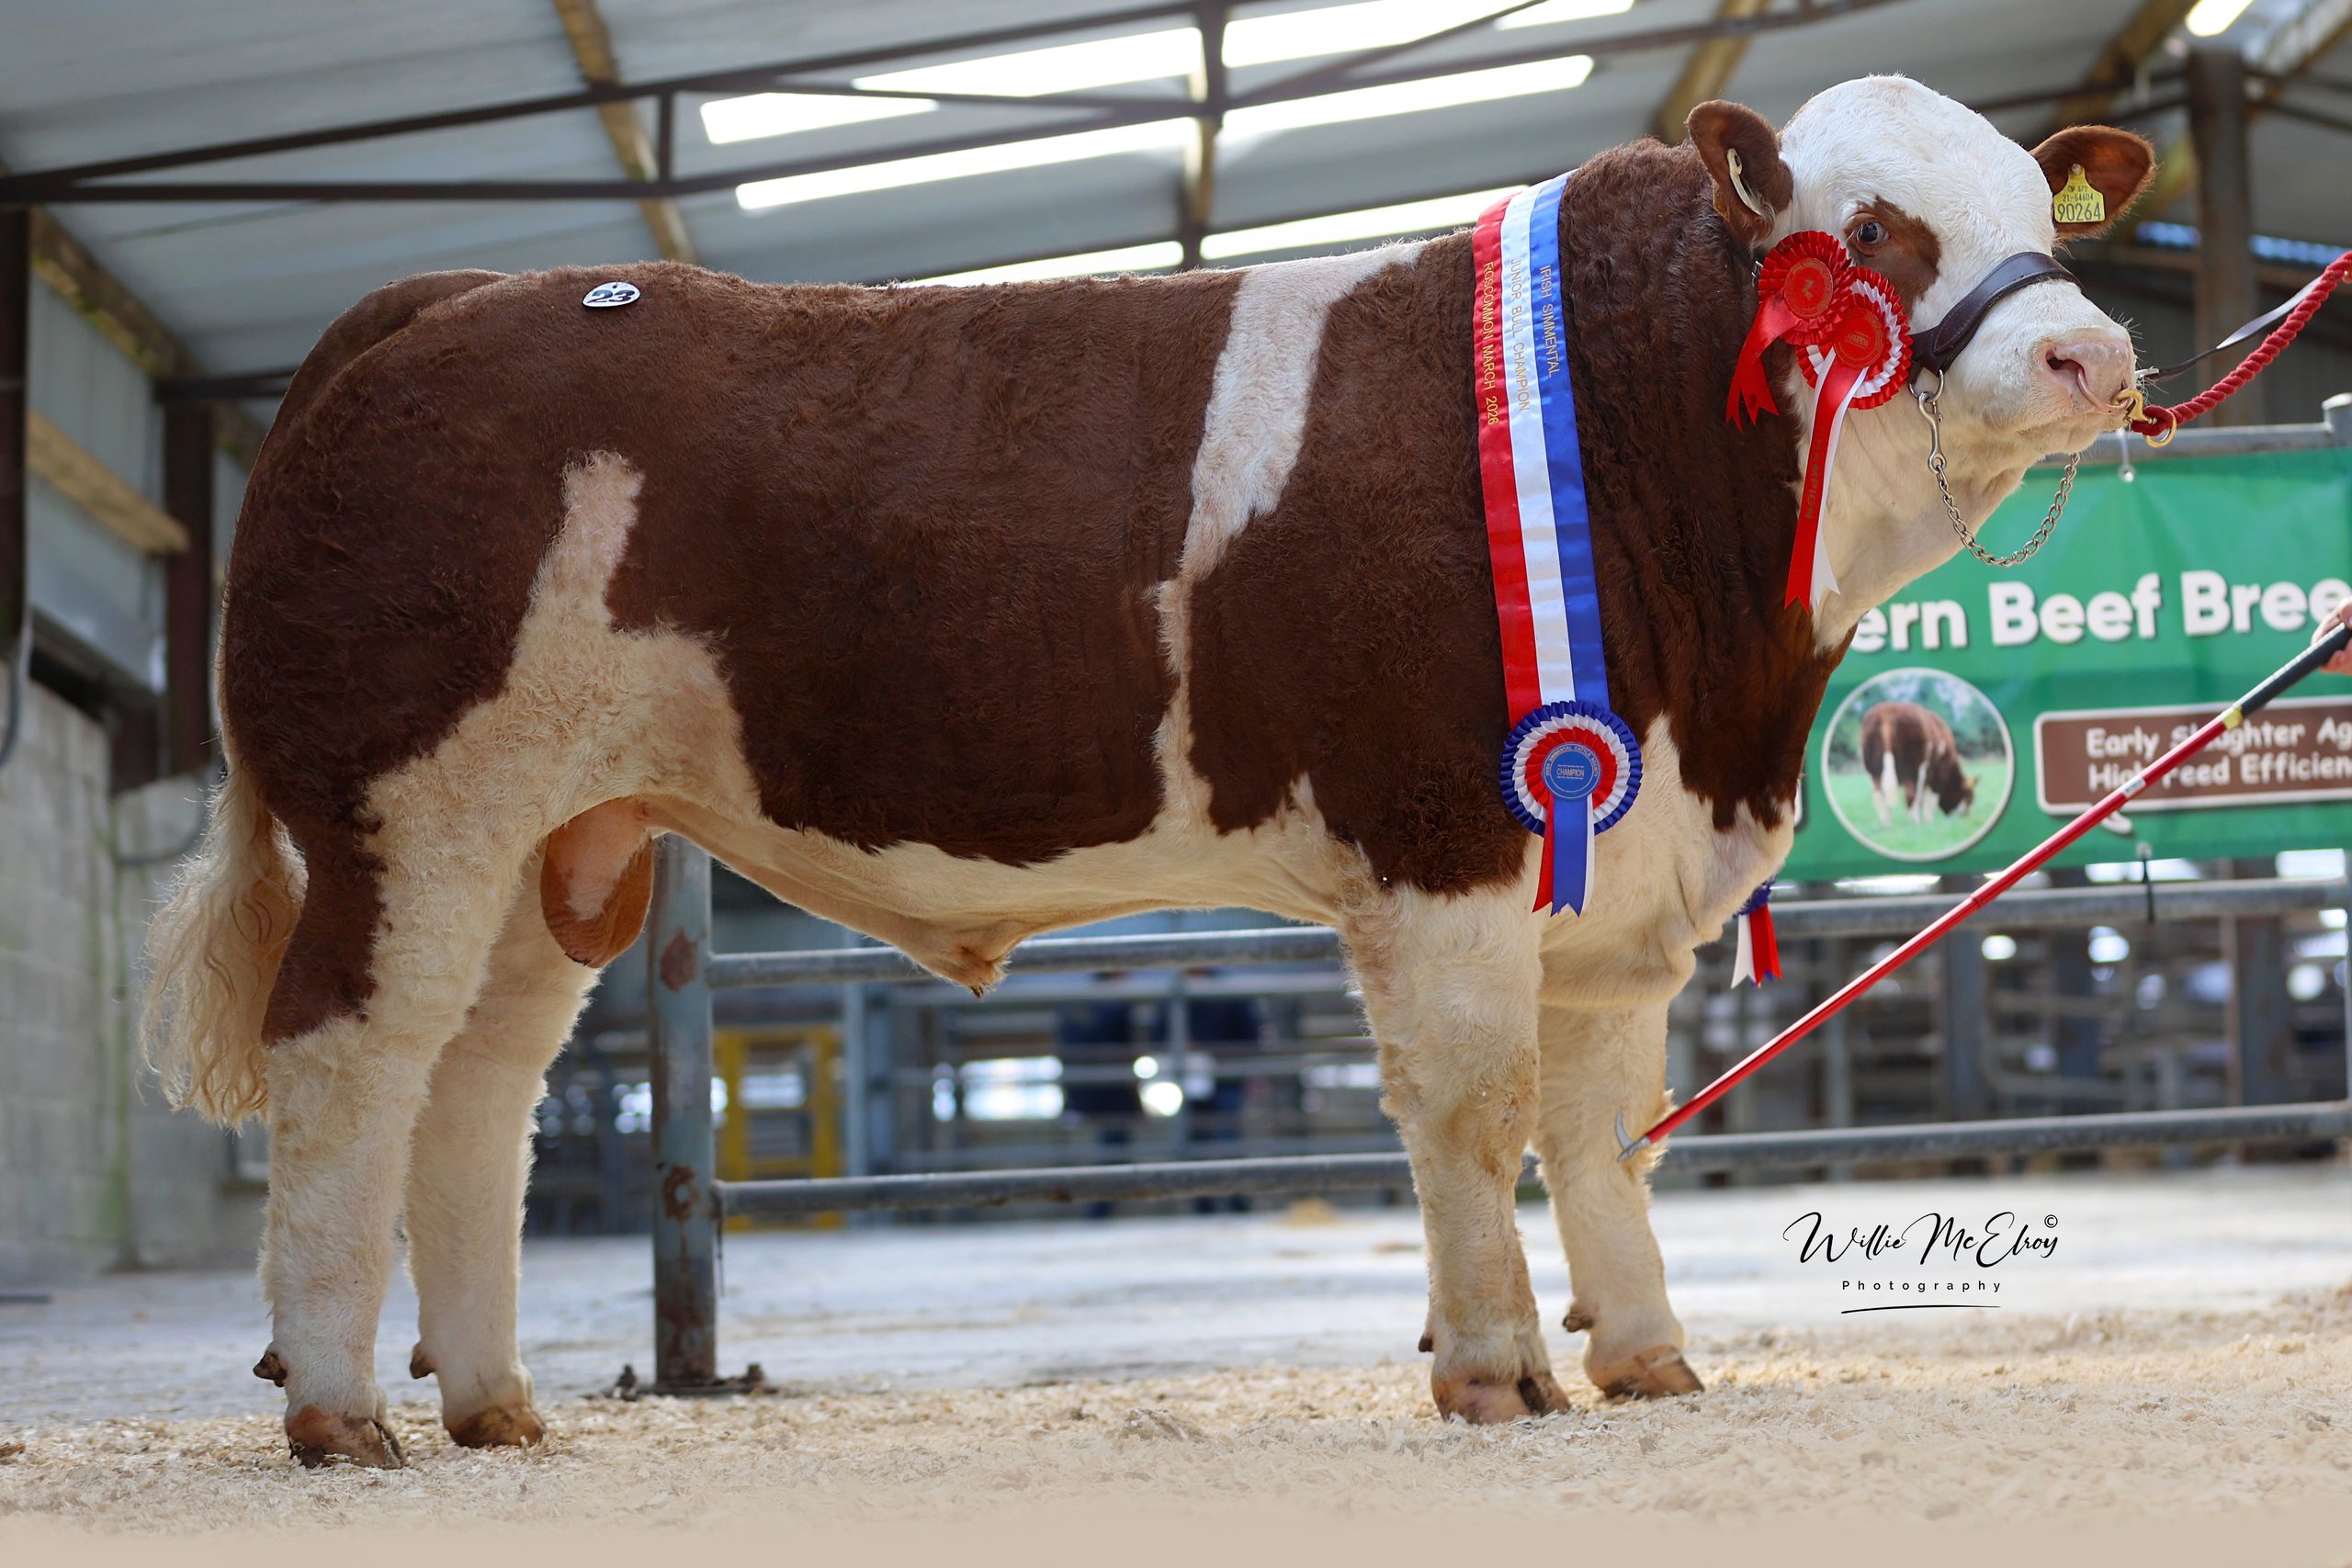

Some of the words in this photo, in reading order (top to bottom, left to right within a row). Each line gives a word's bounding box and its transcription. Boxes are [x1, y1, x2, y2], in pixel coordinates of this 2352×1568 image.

[2058, 203, 2101, 220] 90264
[587, 289, 635, 303] 23
[1510, 258, 1522, 302] JUNIOR
[1540, 265, 1552, 299] IRISH
[1481, 262, 1495, 339] ROSCOMMON
[1510, 306, 1523, 339] BULL
[1542, 304, 1560, 378] SIMMENTAL
[1482, 344, 1497, 390] MARCH
[1512, 341, 1532, 412] CHAMPION
[1485, 396, 1499, 425] 2026
[1988, 571, 2161, 647] Beef
[2086, 726, 2159, 761] Early
[2316, 716, 2352, 751] Ag
[1556, 767, 1585, 777] CHAMPION
[2240, 750, 2352, 784] Efficien
